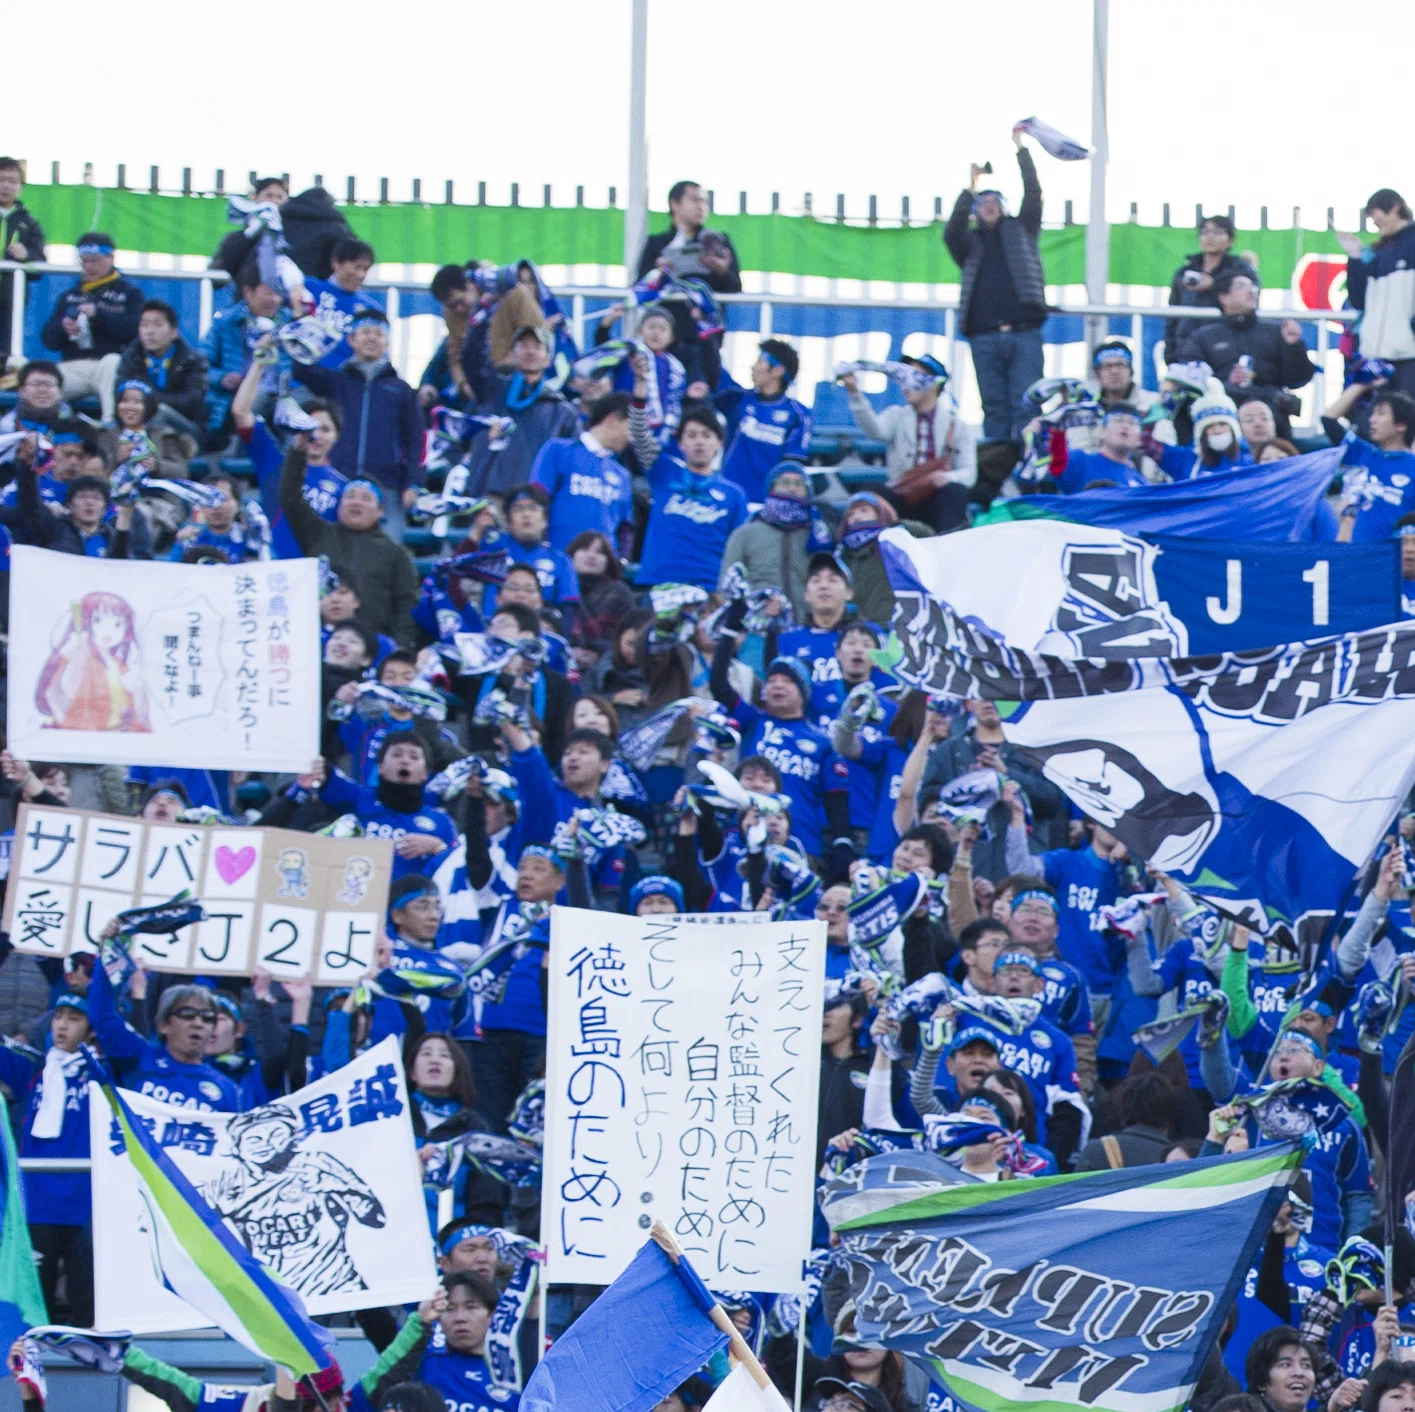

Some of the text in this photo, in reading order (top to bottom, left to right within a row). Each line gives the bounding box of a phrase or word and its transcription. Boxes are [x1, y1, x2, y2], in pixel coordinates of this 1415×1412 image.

[266, 571, 292, 708] 徳島が勝つに
[561, 942, 632, 1259] 徳島のために
[717, 949, 766, 1275] みんな監督のために
[764, 932, 811, 1193] 支えてくれた
